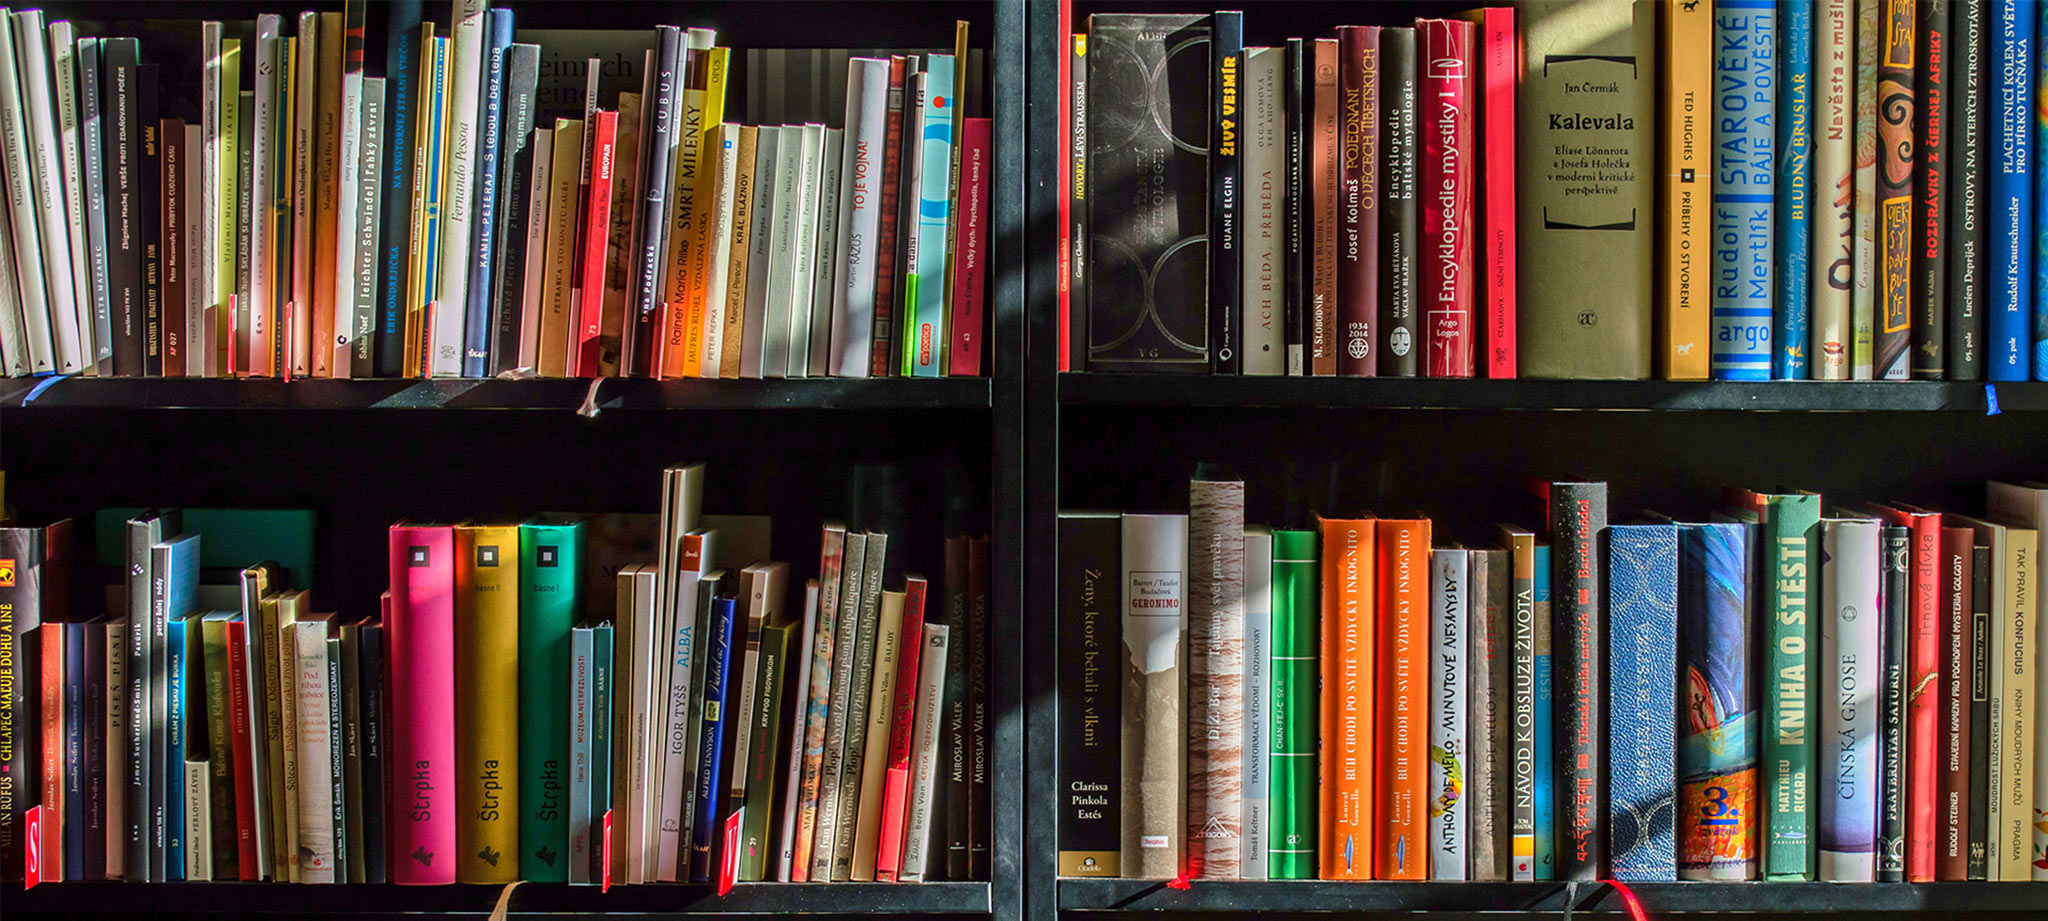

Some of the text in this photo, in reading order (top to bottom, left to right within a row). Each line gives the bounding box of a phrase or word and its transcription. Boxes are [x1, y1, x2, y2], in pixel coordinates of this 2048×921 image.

[116, 67, 125, 91] POÉZIE
[488, 47, 501, 74] teba
[711, 60, 721, 83] OPUS
[1565, 81, 1619, 94] Jan Čermák
[1929, 30, 1942, 84] AFRIKY
[117, 95, 126, 141] ZDAŇOVANIU
[486, 79, 499, 99] bez
[658, 71, 672, 132] KUBUS
[1073, 82, 1085, 157] LÉVI-STRAUSSEM
[1220, 57, 1236, 155] ŽIVÝ VESMÍR
[1721, 15, 1748, 185] STAROVĚKÉ
[1754, 15, 1772, 185] BÁJE A POVĚSTI
[1925, 89, 1941, 147] ČIERNEJ
[2015, 39, 2027, 173] PRO PÍRKO TUČŇÁKA
[366, 103, 377, 138] závrat
[484, 115, 496, 149] tebou
[1345, 89, 1359, 169] POJEDNÁNÍ
[1361, 50, 1377, 209] O VĚCECH TIBETSKÝCH
[1403, 80, 1413, 199] baltské mytologie
[1549, 113, 1634, 131] Kalevala
[1555, 145, 1628, 156] Eliase Lönnrota
[1683, 91, 1693, 161] TED HUGHES
[1789, 73, 1806, 220] BLUDNÝ BRUSLAŘ
[118, 166, 127, 188] VERŠE
[450, 123, 468, 222] Fernando Pessoa
[484, 154, 493, 162] S
[601, 144, 611, 179] EUROPAIN
[676, 105, 701, 230] SMRŤ MILENKY
[854, 141, 868, 211] TO JE VOJNA!
[1075, 164, 1084, 199] HOVORY
[1389, 109, 1401, 199] Encyklopedie
[1553, 158, 1630, 169] a Josefa Holečka
[1556, 171, 1634, 182] moderní kritické
[119, 193, 129, 217] Machej
[362, 186, 373, 246] Schwindel
[481, 174, 493, 224] PETERAJ
[736, 174, 749, 216] BLÁZNOV
[1224, 177, 1233, 249] DUANE ELGIN
[1346, 179, 1358, 261] Josef Kolmaš
[1441, 104, 1459, 302] Encyklopedie mystiky
[1926, 168, 1941, 258] ROZPRÁVKY
[121, 219, 129, 250] Zbigniew
[479, 231, 489, 267] KAMIL
[848, 234, 862, 265] RÁZUS
[1259, 170, 1274, 330] ACH BĚDA, PŘEBĚDA
[1680, 191, 1691, 308] PRÍBEHY O STVORENÍ
[1718, 210, 1739, 298] Rudolf
[1749, 209, 1768, 298] Mertlík
[2008, 197, 2020, 311] Rudolf Krautschneider
[95, 245, 103, 291] MAZANEC
[361, 252, 371, 297] leichter
[386, 247, 400, 333] ERIK ONDREJIČKA
[670, 240, 690, 345] Rainer Maria Rilke
[1964, 241, 1975, 317] Lucien Deprijck
[1719, 326, 1769, 350] argo
[1578, 500, 1591, 578] Bardo thödol
[1132, 599, 1179, 610] GERONIMO
[133, 623, 142, 656] Pazúrik
[677, 626, 692, 668] ALBA
[1341, 530, 1358, 780] BŮH CHODÍ PO SVĚTĚ VŽDYCKY INKOGNITO
[1776, 537, 1805, 744] KNIHA O ŠTĚSTÍ
[1949, 555, 1963, 771] STAVEBNÍ KAMENY PRO POCHOPENÍ MYSTERIA GOLGOTY
[1513, 589, 1531, 808] NÁVOD K OBSLUZE ŽIVOTA
[1578, 613, 1592, 746] Tibetská kniha mrtvých
[1, 713, 12, 761] CHLAPEC
[133, 678, 142, 785] James Sutherland-Smith
[672, 685, 686, 755] IGOR TYŠŠ
[952, 702, 963, 781] MIROSLAV VÁLEK
[1838, 655, 1857, 799] ČÍNSKÁ GNOSE
[1886, 664, 1900, 821] FRATERNITAS SATURNI
[407, 761, 435, 821] Štrpka
[476, 761, 503, 821] Štrpka
[535, 760, 562, 821] Štrpka
[702, 727, 714, 798] ALFRED TENNYSON
[825, 749, 840, 776] Plop!
[1071, 781, 1108, 793] Clarissa
[1778, 760, 1790, 812] MATTHIEU
[1794, 772, 1806, 812] RICARD
[1072, 795, 1108, 807] Pinkola
[1078, 808, 1101, 820] Estés
[1949, 792, 1959, 856] RUDOLF STEINER
